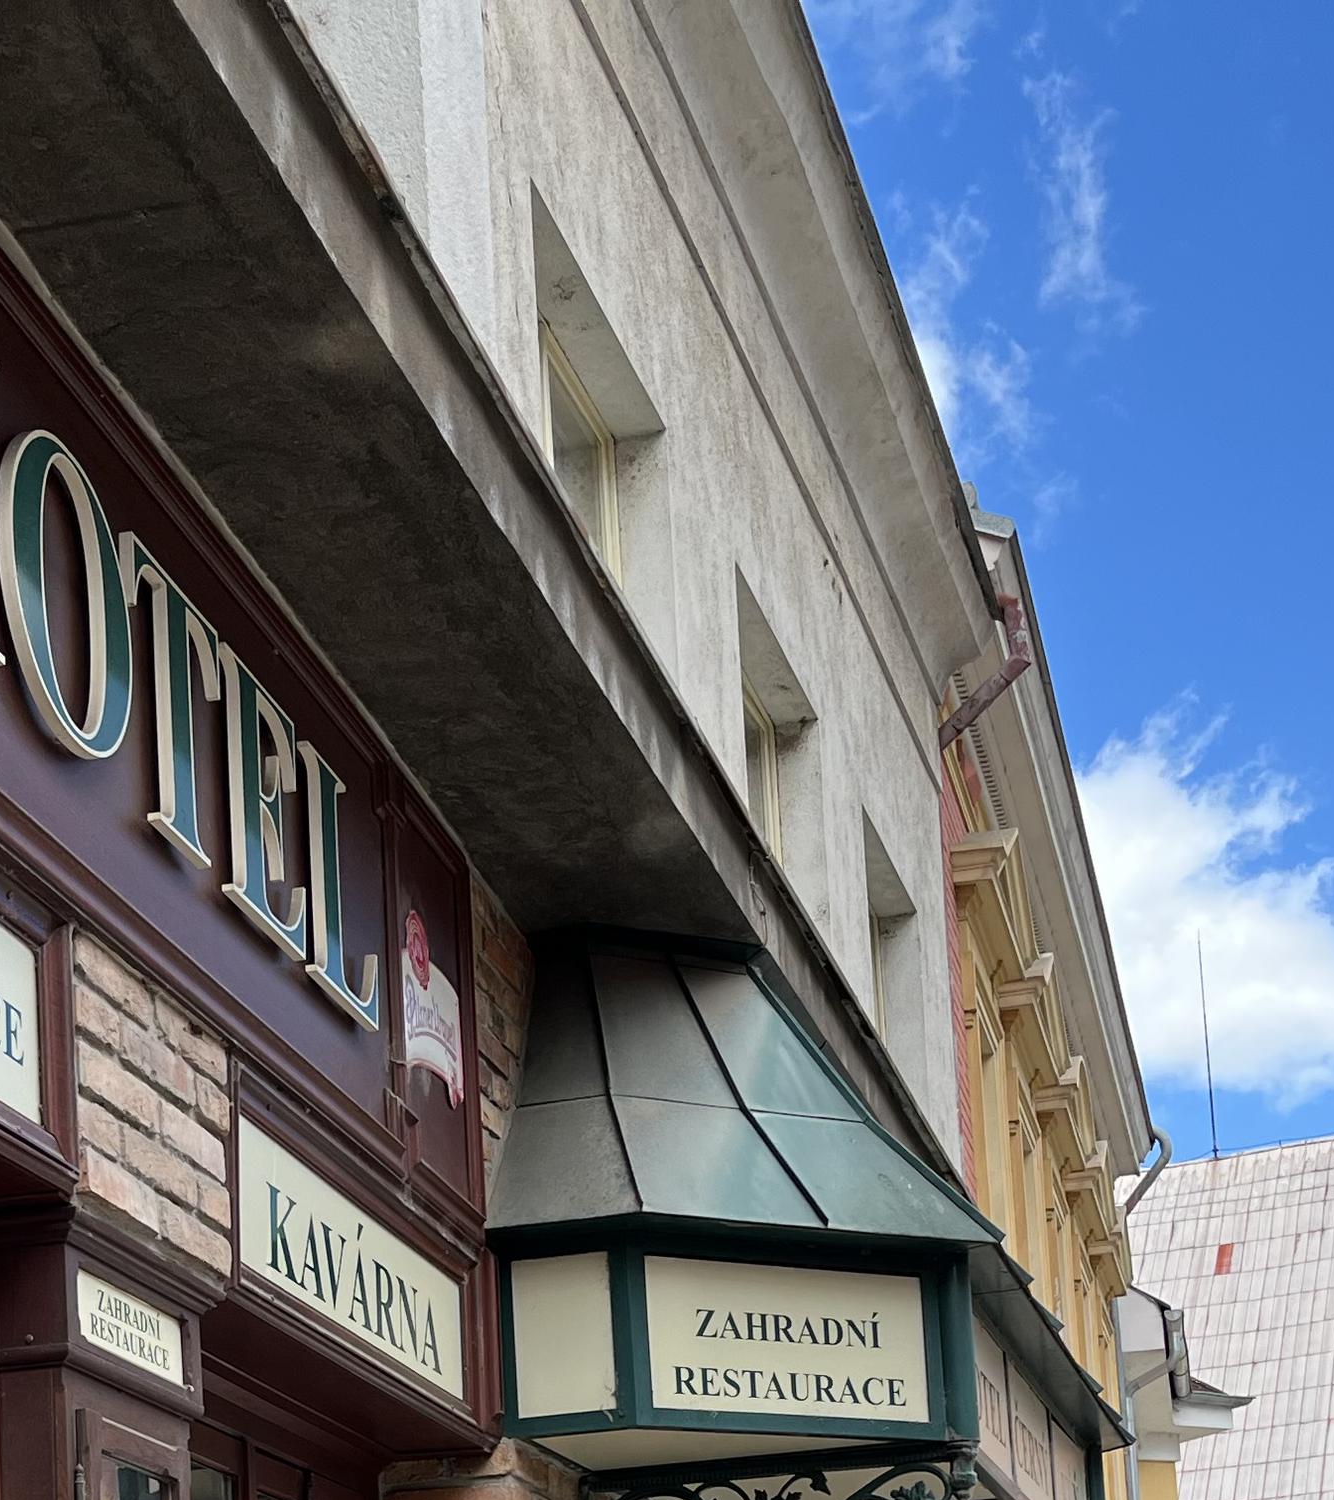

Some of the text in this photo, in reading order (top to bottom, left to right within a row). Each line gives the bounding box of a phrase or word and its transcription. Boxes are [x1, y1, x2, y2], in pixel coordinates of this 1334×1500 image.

[266, 1182, 442, 1376] KAVÁRNA
[96, 1289, 161, 1341] ZAHRADNÍ
[695, 1308, 882, 1349] ZAHRADNÍ
[90, 1313, 170, 1371] RESTAURACE
[673, 1365, 907, 1408] RESTAURACE
